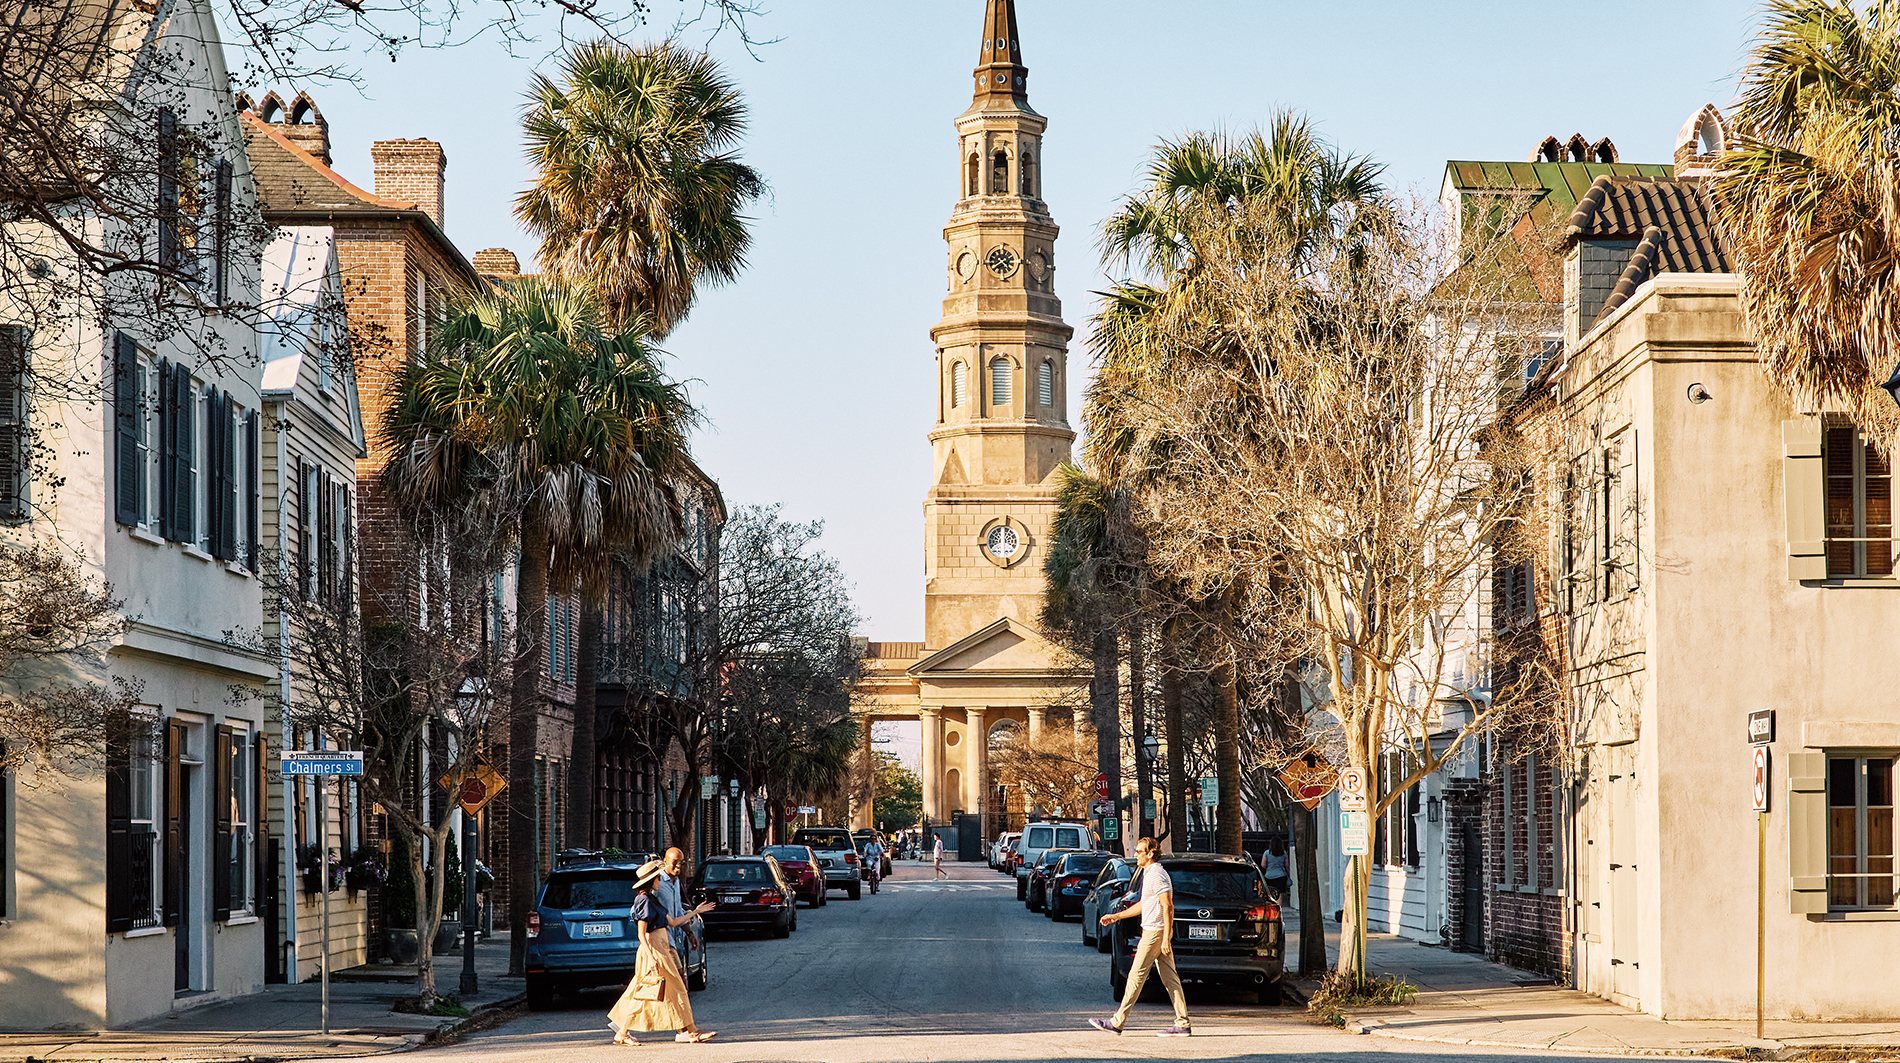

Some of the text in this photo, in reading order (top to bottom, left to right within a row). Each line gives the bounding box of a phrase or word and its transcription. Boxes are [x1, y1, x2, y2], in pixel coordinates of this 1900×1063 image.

[289, 761, 354, 774] Chalmers St
[1096, 780, 1108, 790] ST
